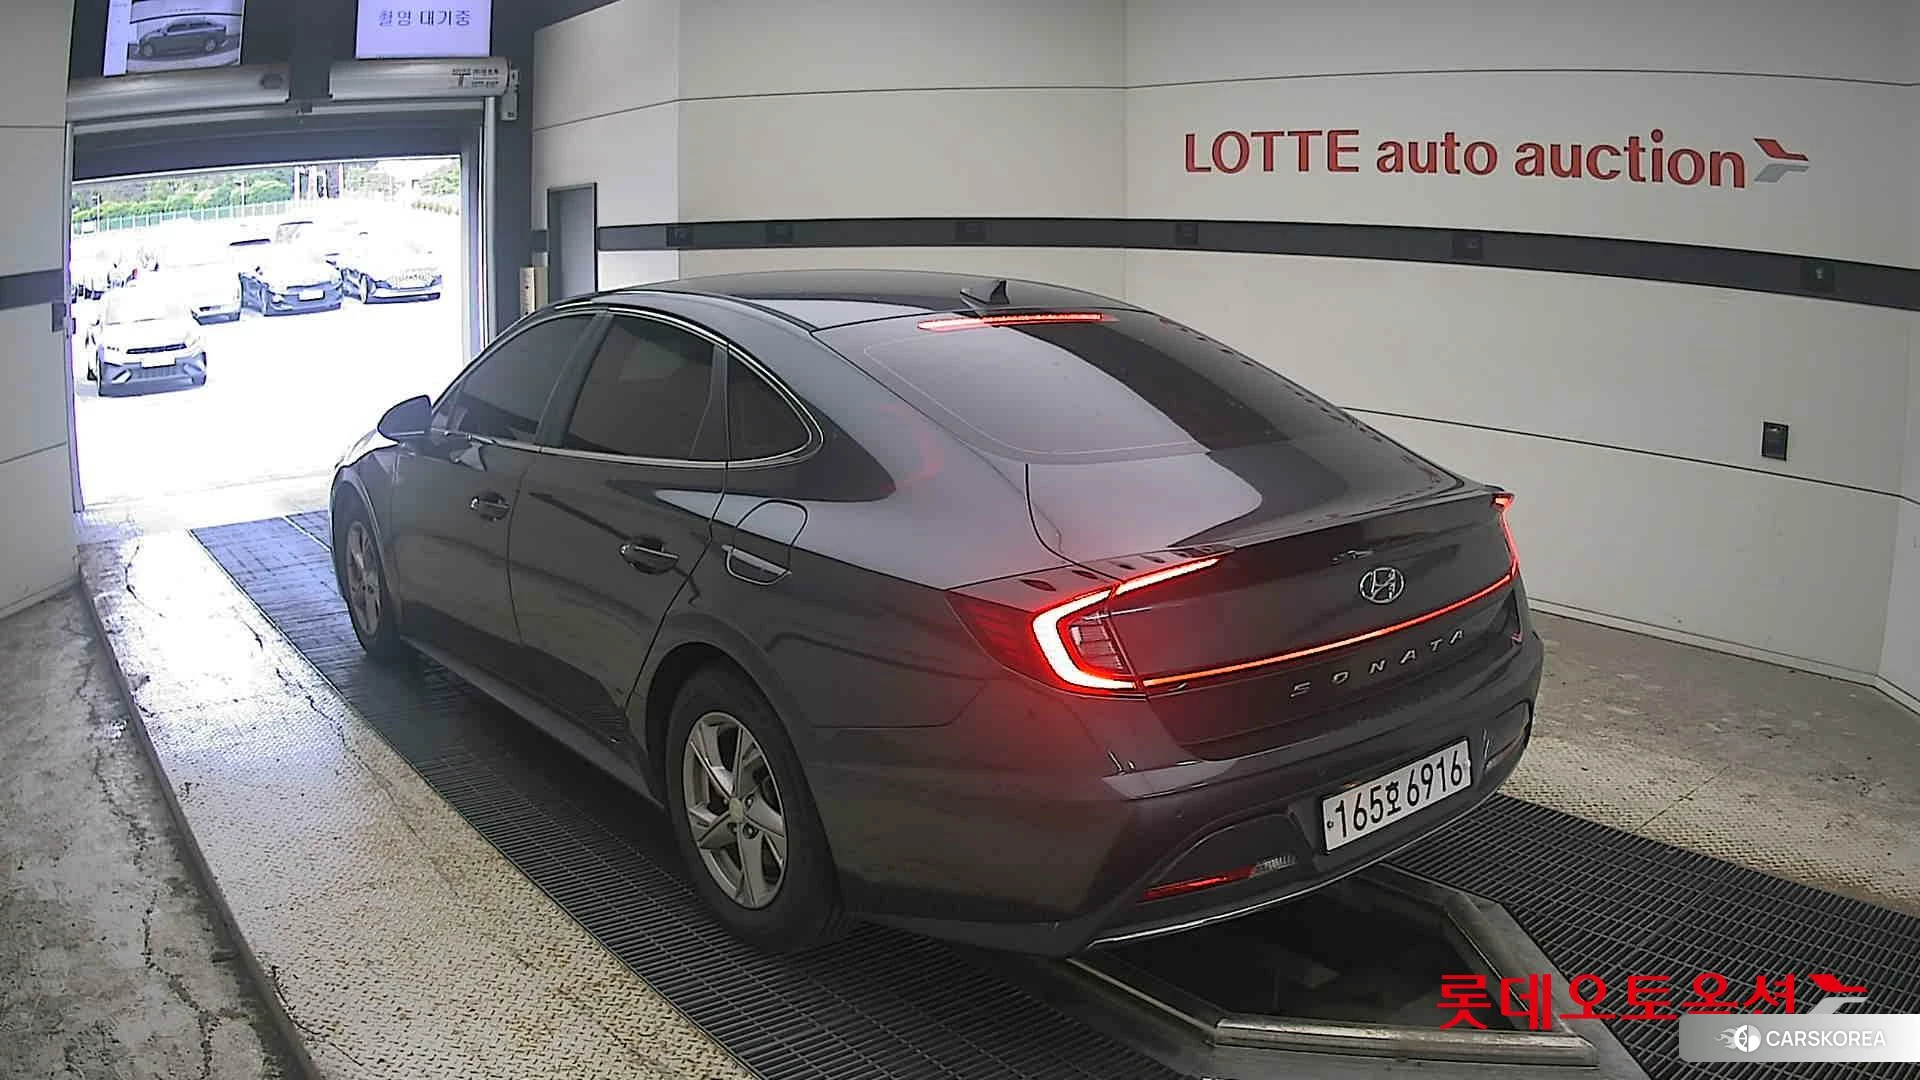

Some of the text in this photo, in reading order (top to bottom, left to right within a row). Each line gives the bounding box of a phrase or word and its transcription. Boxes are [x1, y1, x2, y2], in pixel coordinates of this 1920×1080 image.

[420, 10, 471, 26] 대기중
[1185, 129, 1746, 189] LOTTE auto auction
[1290, 629, 1465, 698] SONATA
